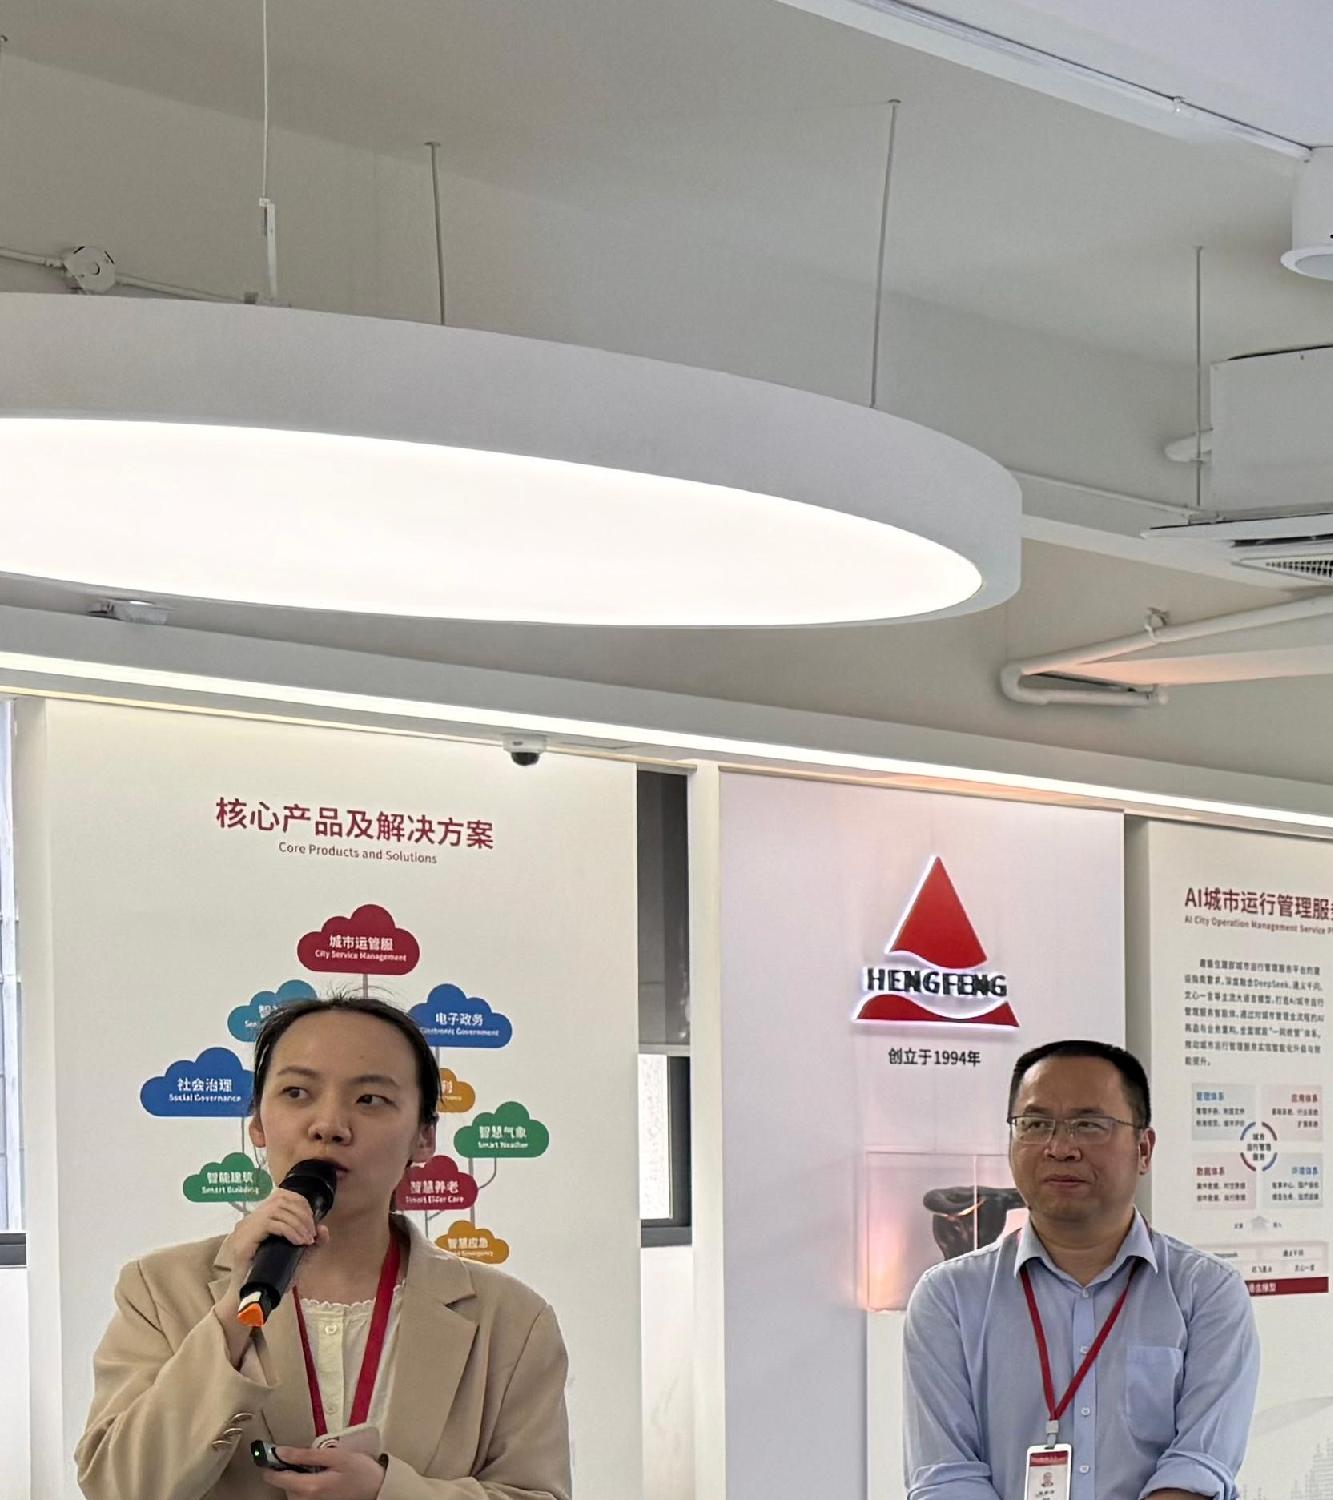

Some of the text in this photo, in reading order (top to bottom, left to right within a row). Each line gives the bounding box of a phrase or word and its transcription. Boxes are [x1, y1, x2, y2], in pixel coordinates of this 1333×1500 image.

[215, 796, 494, 850] 核心产品及解决方案
[278, 841, 437, 864] Core Products and Solutions
[1184, 915, 1193, 923] AI
[1194, 916, 1209, 927] City
[1211, 917, 1249, 928] Operation
[1251, 920, 1298, 932] Management
[1300, 924, 1326, 935] Service
[329, 934, 393, 951] 城市运管服
[315, 949, 407, 962] City Service Management
[866, 967, 1009, 997] HENGFENG
[435, 1011, 484, 1027] 电子政务
[456, 1027, 499, 1037] Government
[888, 1047, 981, 1067] 创立于1994年
[176, 1077, 233, 1093] 社会治理
[168, 1093, 242, 1103] Social Governance
[479, 1125, 527, 1140] 智慧气象
[410, 1179, 459, 1194] 智慧养老
